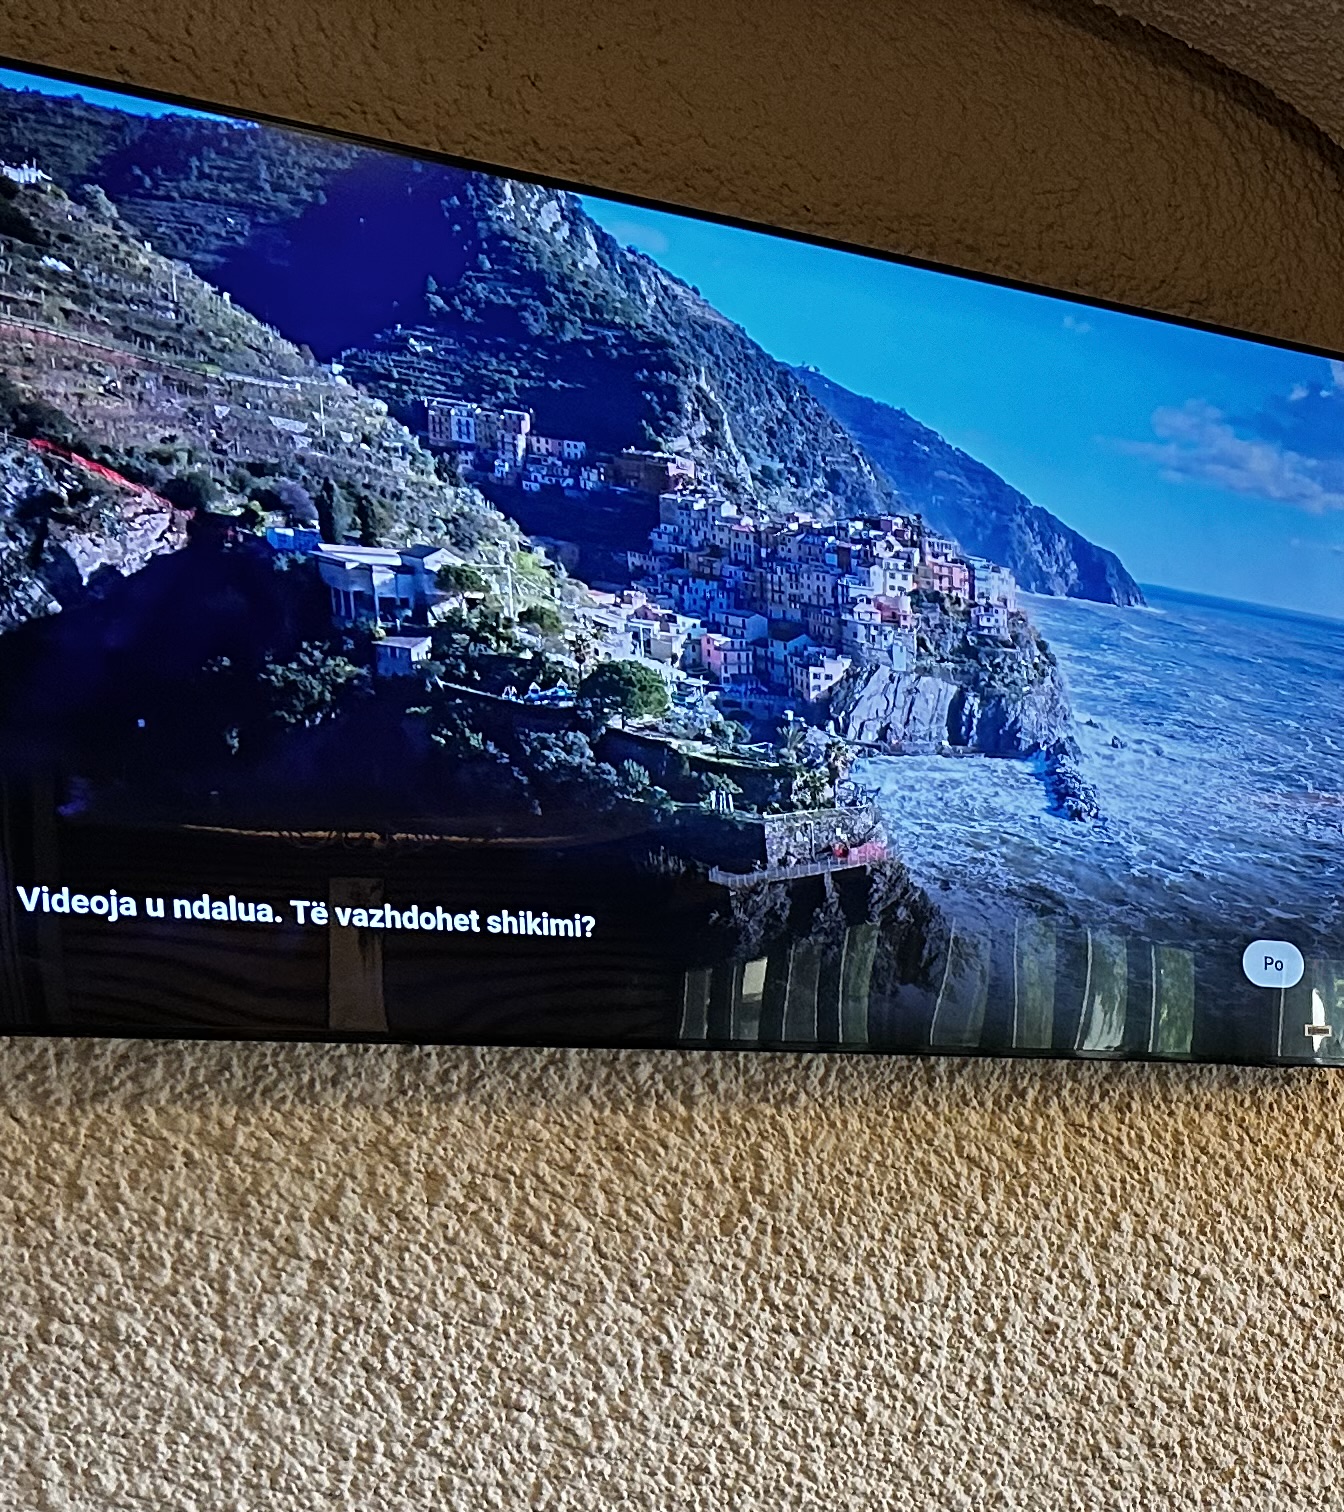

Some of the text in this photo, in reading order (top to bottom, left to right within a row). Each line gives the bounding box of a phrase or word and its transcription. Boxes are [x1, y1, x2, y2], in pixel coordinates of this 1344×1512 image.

[16, 885, 596, 938] Videoja u ndalua. Të vazhdohet shikimi?
[1263, 955, 1285, 972] Po
